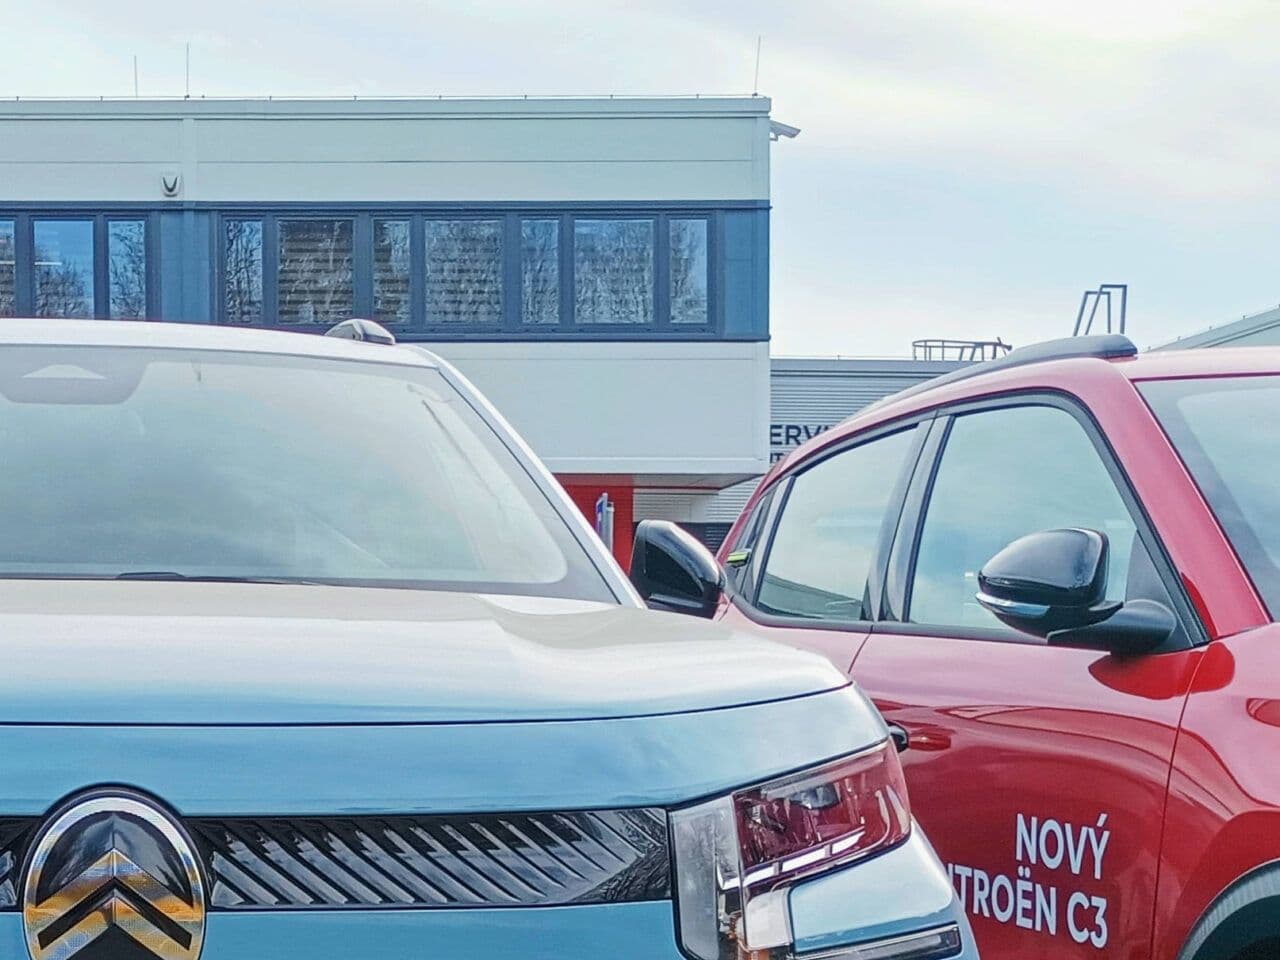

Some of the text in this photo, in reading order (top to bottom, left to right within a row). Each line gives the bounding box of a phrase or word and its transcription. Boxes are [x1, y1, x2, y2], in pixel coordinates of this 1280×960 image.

[770, 424, 829, 446] ERV
[1016, 813, 1110, 880] NOVÝ
[946, 862, 1108, 949] TROËN C3
